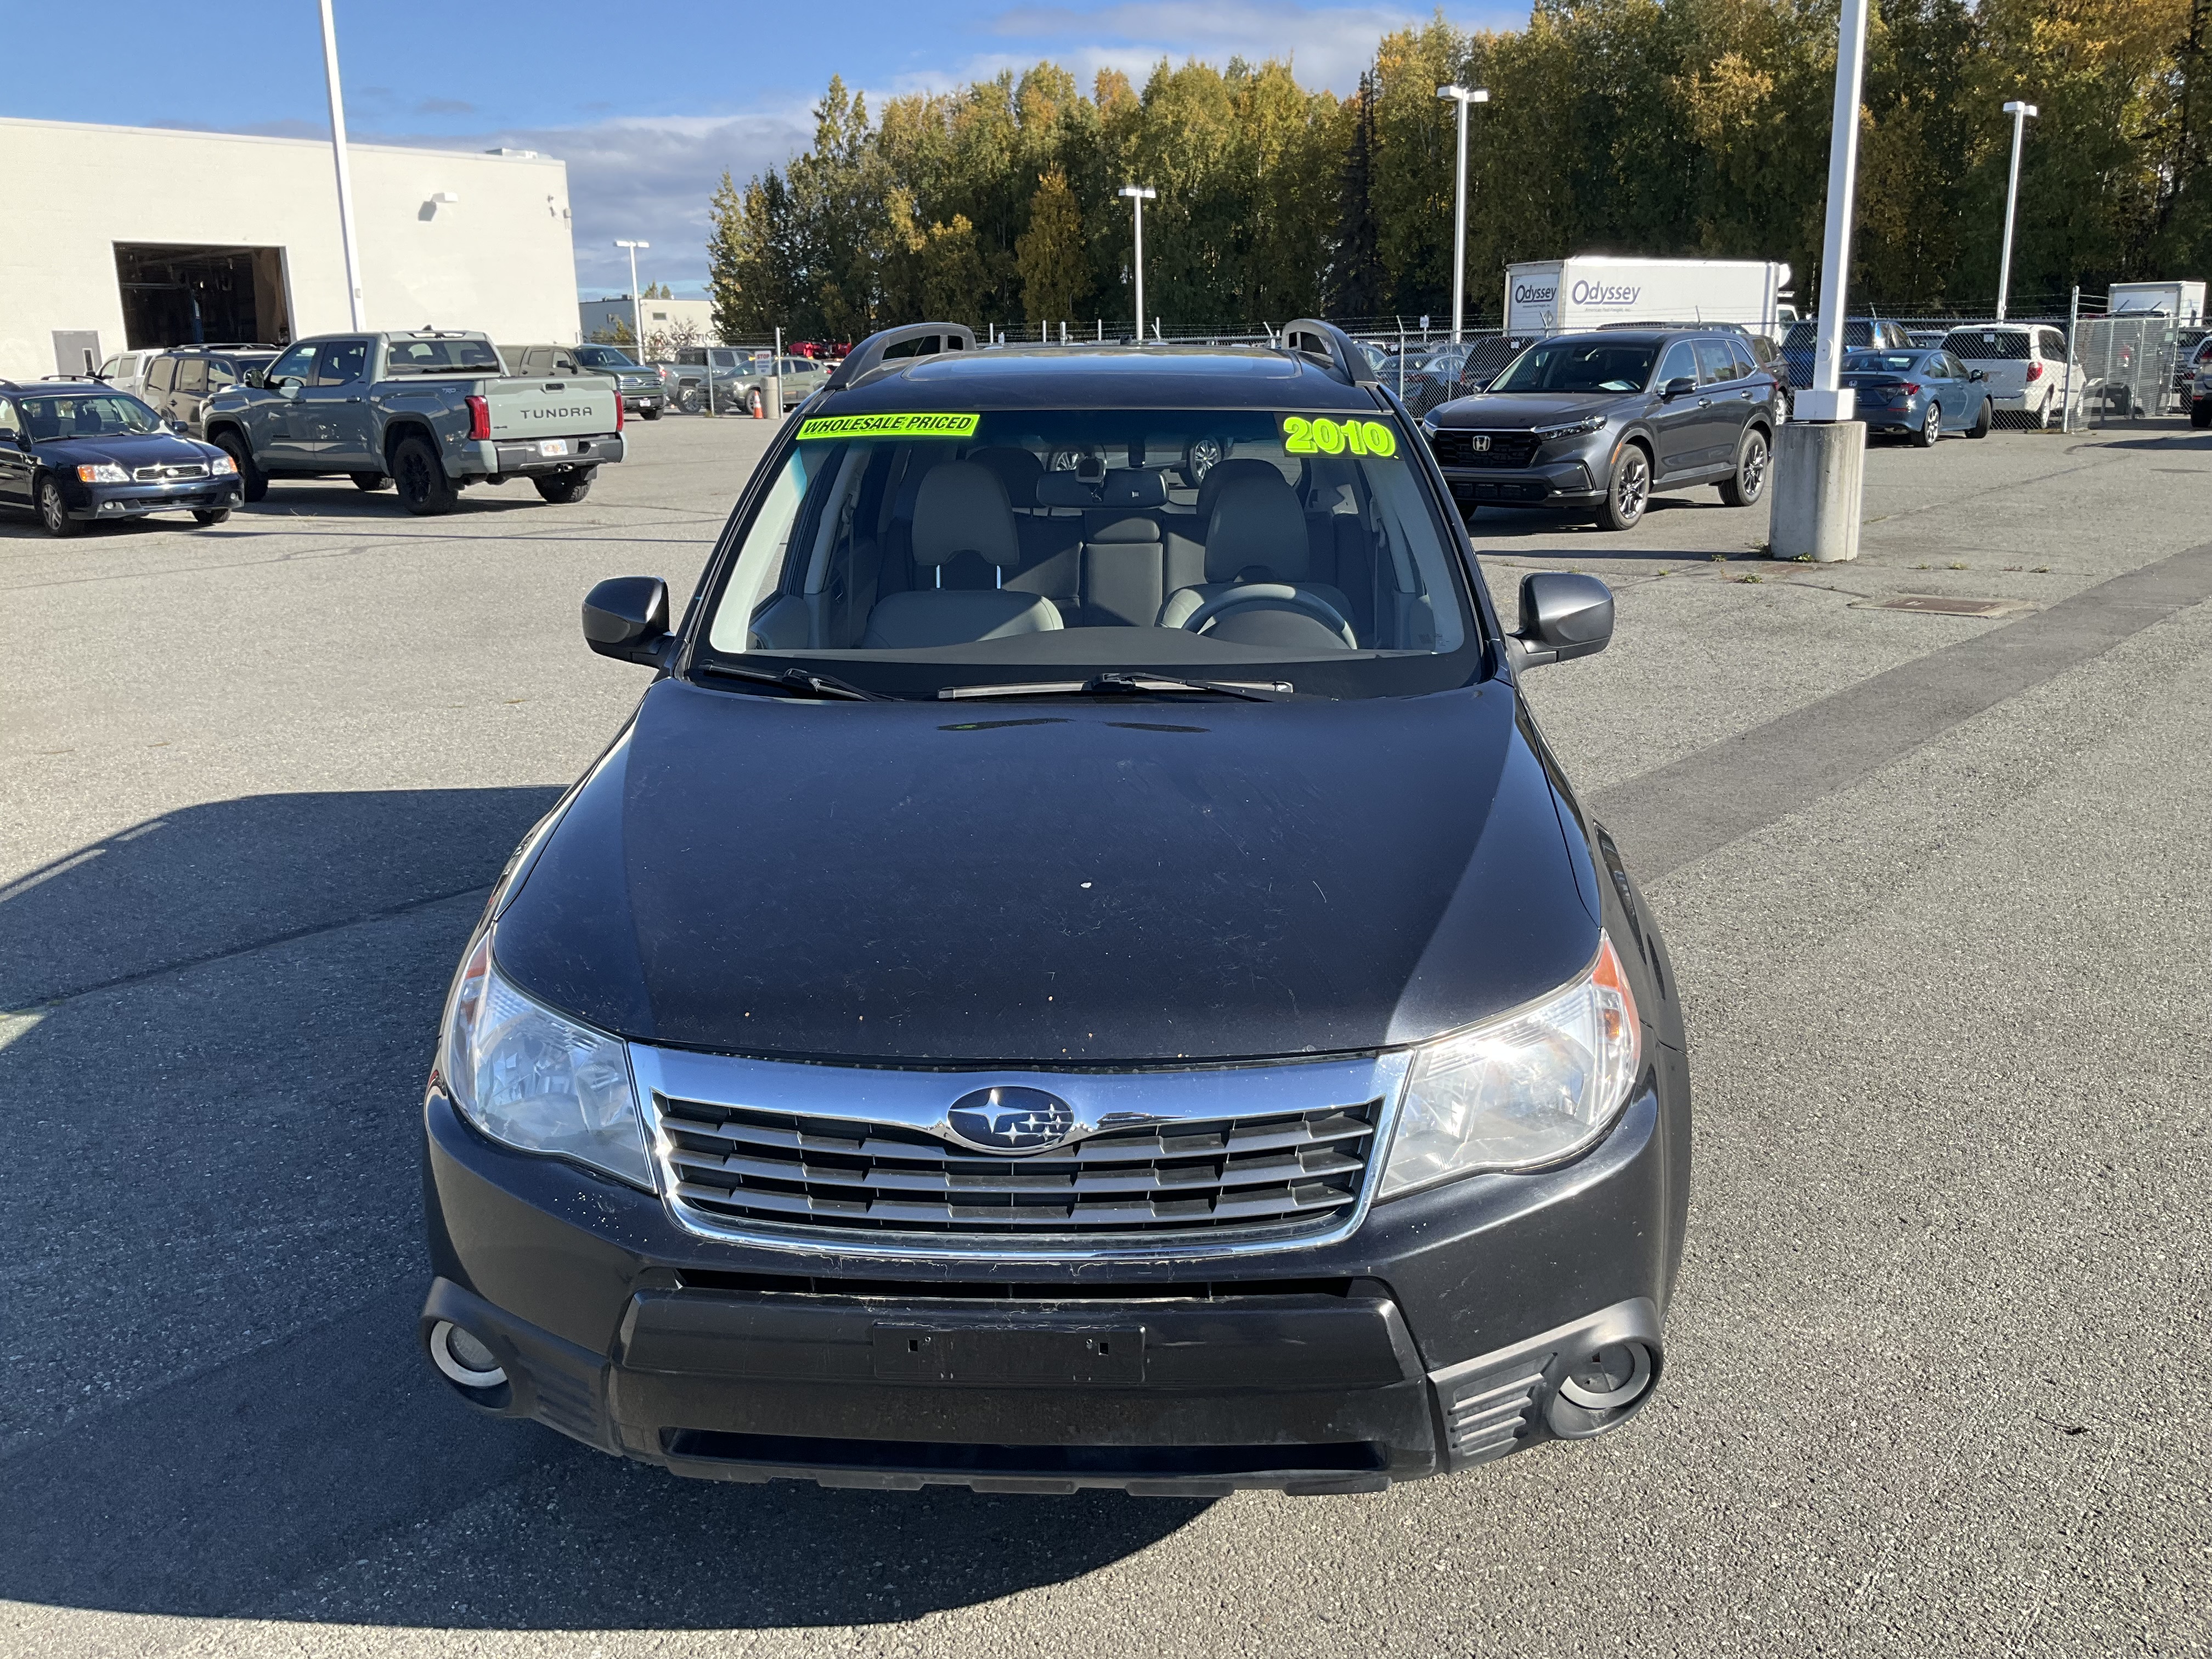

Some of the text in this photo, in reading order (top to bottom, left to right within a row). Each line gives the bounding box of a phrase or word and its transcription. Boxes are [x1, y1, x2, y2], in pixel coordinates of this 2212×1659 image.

[1515, 285, 1557, 303] Odyssey
[1572, 280, 1641, 304] Odyssey
[520, 407, 592, 419] TUNDRA
[804, 416, 975, 435] WHOLESALE PRICED
[1283, 416, 1396, 457] 2010
